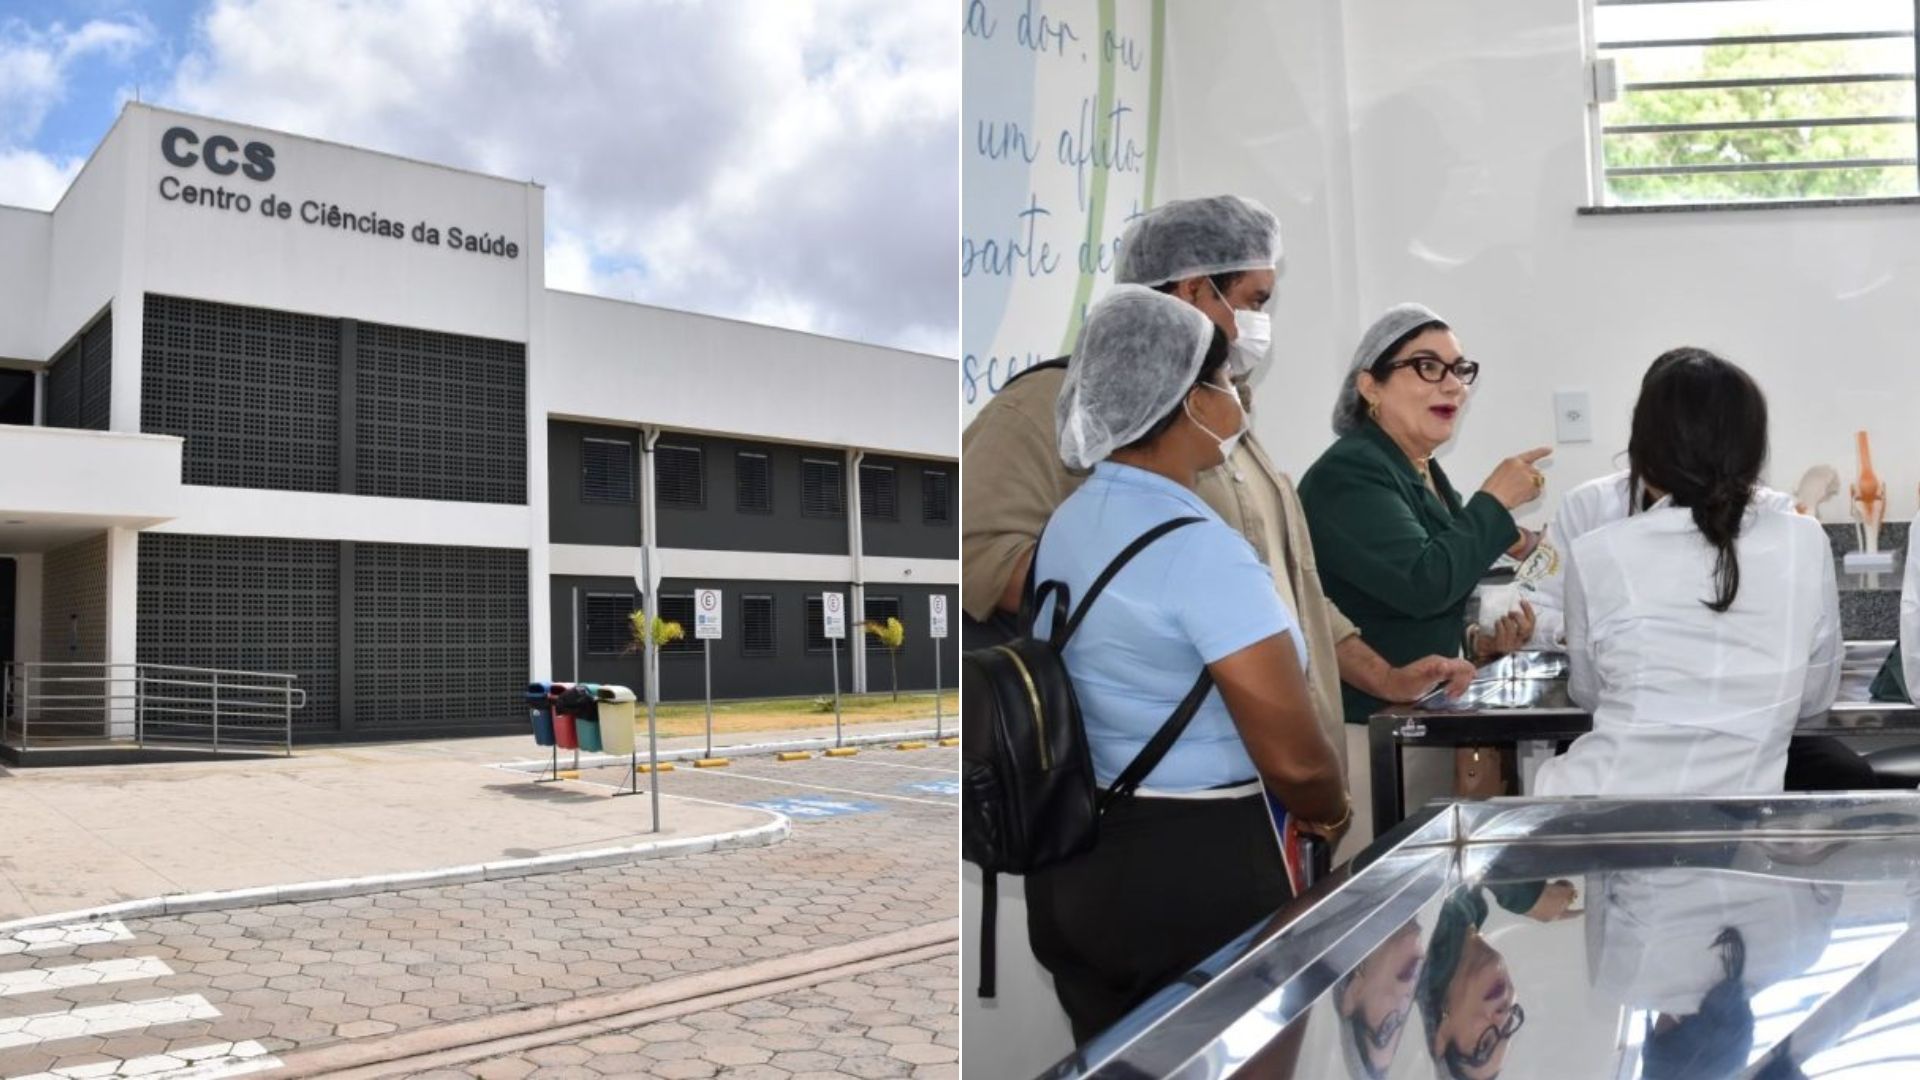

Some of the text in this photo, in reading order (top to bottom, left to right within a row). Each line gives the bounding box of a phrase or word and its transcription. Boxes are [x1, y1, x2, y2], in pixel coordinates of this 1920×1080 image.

[1104, 29, 1144, 72] ou
[161, 126, 276, 182] CCS
[978, 119, 1041, 164] um
[159, 175, 519, 259] Centro de Ciências da Saúde
[962, 192, 1060, 278] parte
